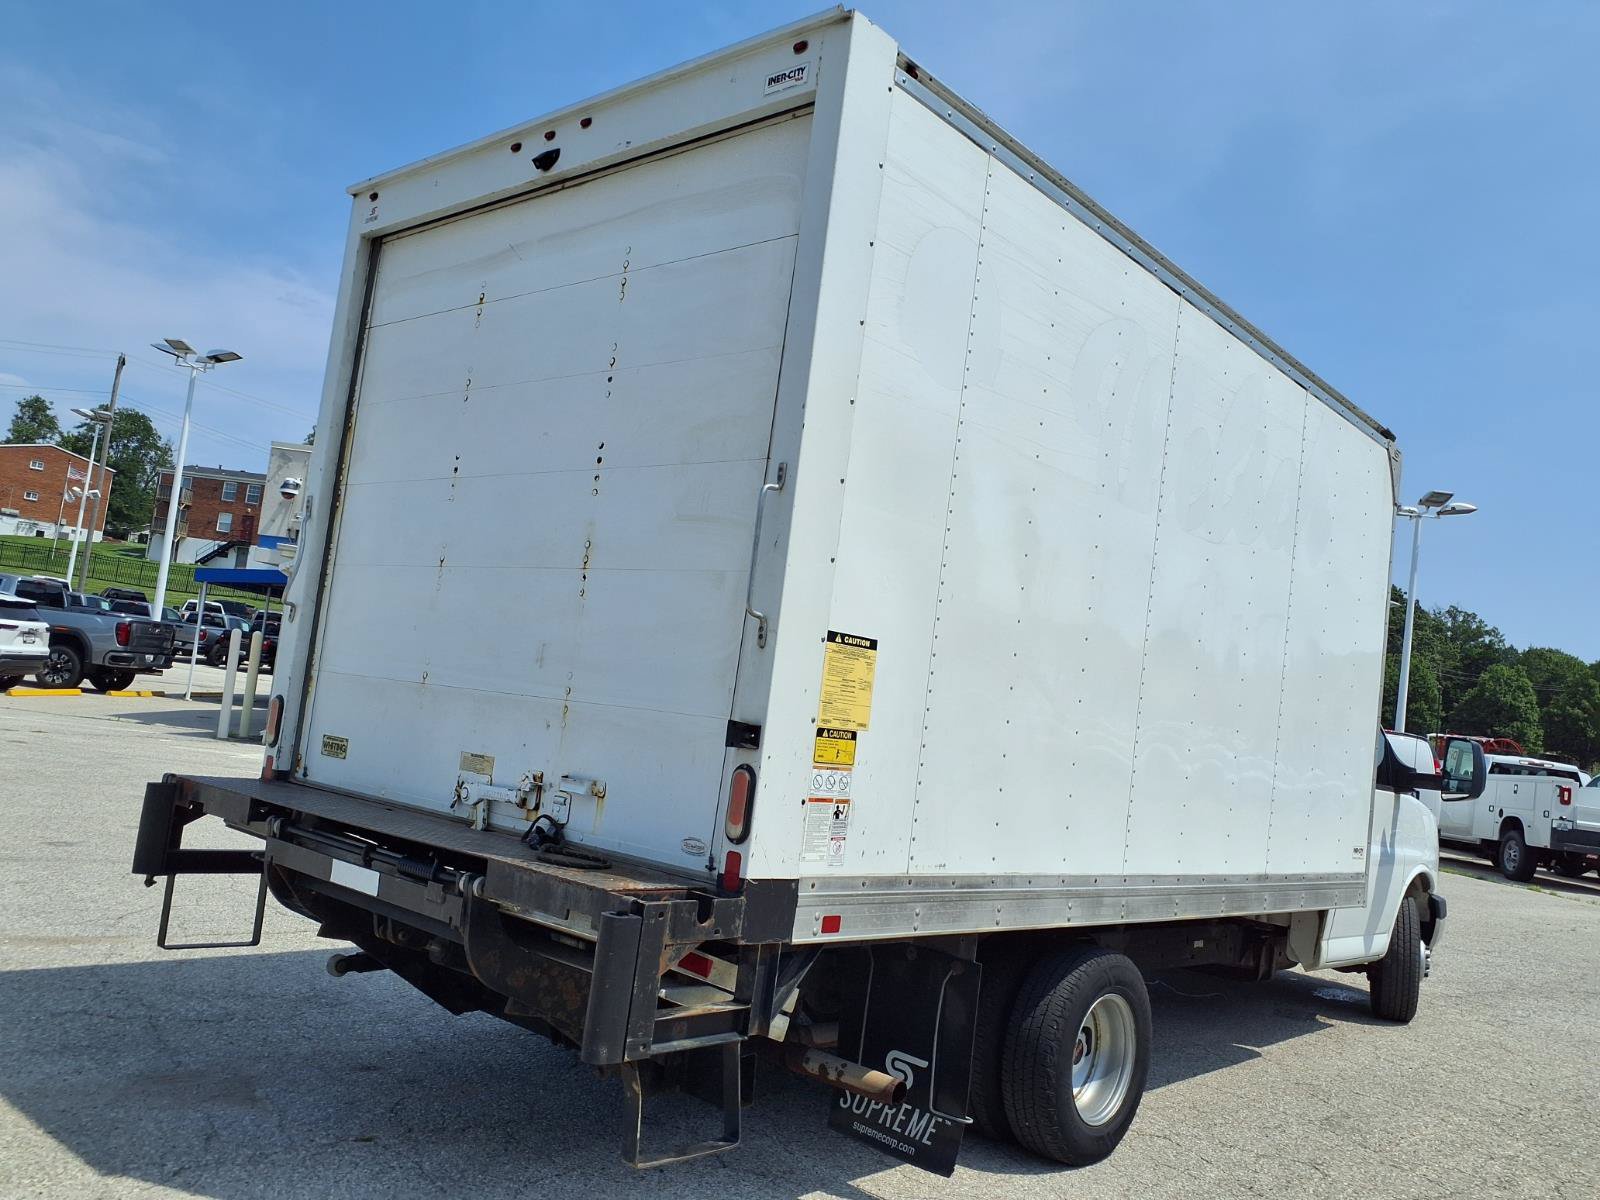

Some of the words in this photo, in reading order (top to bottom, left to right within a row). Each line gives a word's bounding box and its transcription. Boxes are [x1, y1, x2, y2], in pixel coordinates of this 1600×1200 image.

[768, 67, 806, 86] INER-CITY
[844, 636, 870, 647] CAUTION
[829, 730, 852, 740] CAUTION
[852, 1120, 916, 1156] supremecorp.com
